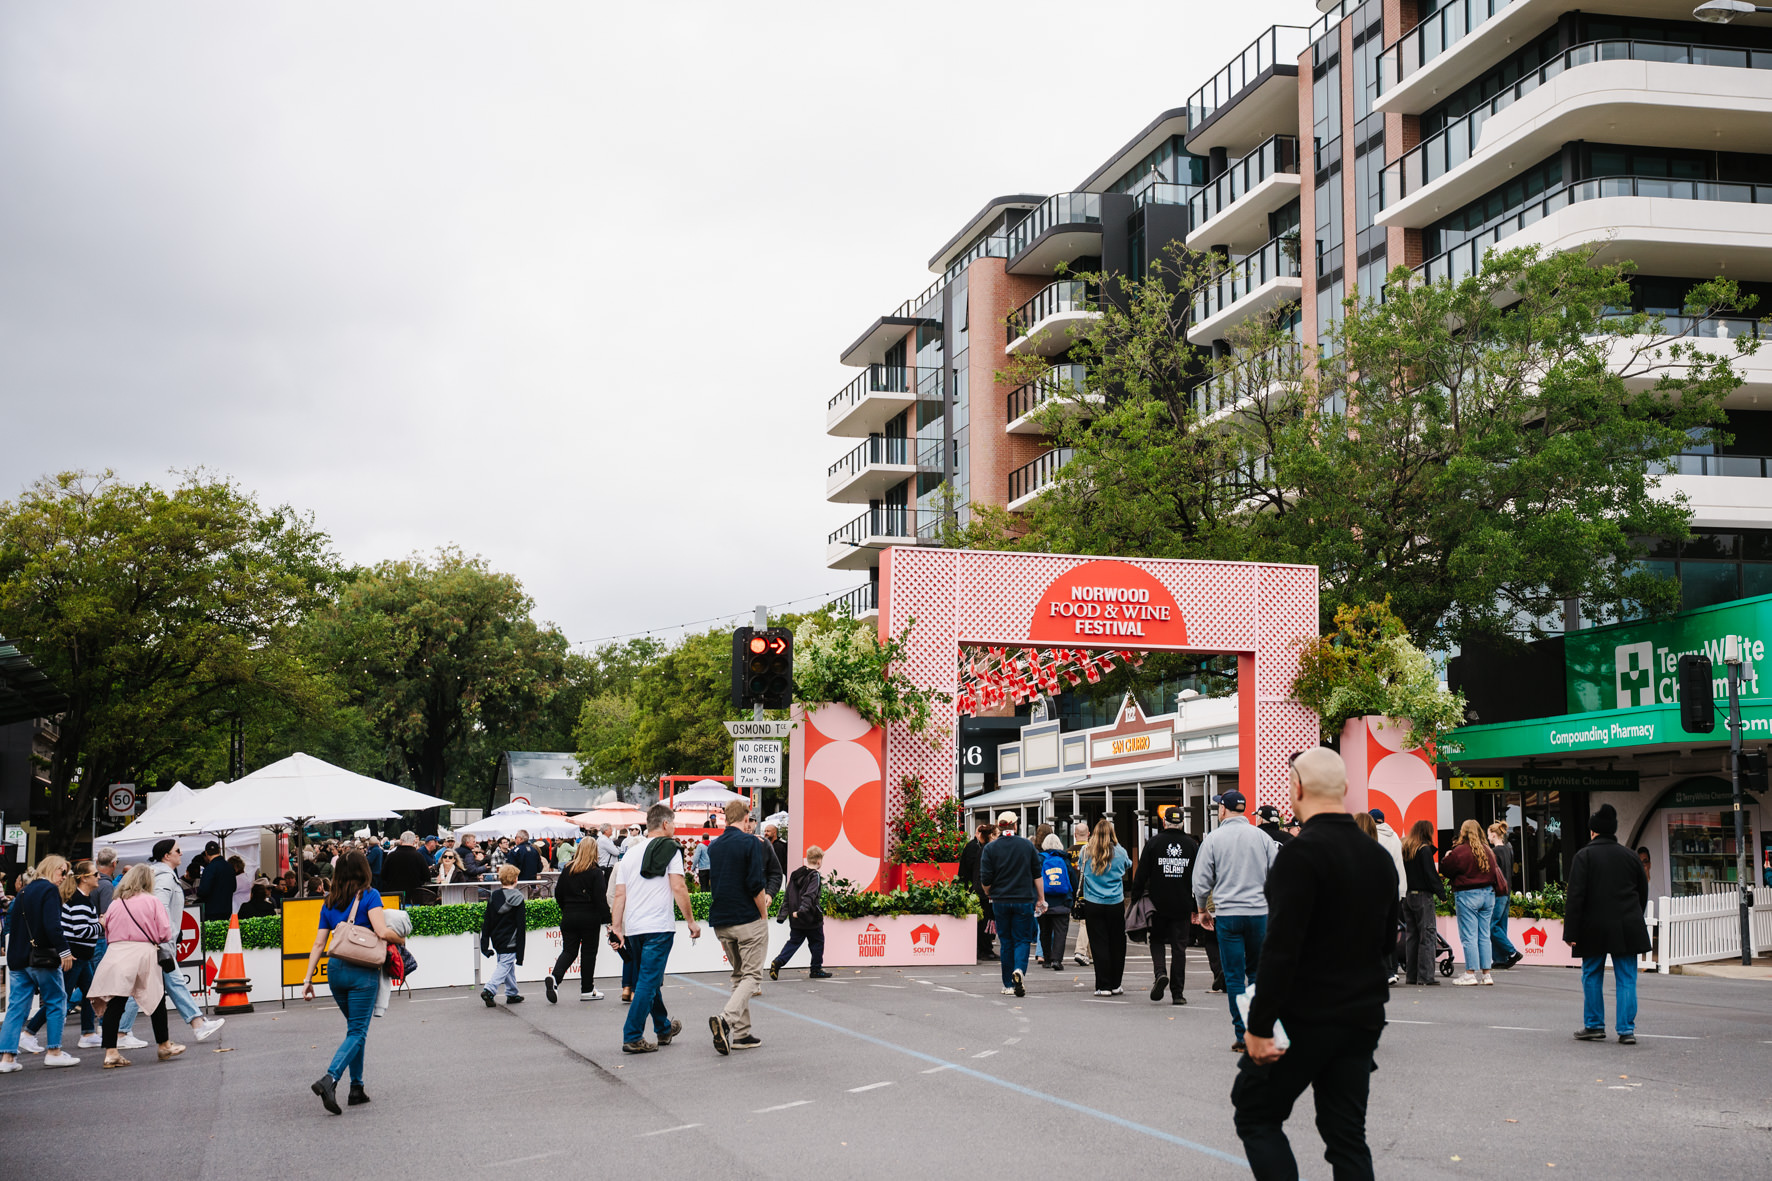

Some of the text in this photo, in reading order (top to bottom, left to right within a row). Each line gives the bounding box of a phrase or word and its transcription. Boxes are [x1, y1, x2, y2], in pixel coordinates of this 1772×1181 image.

[1071, 586, 1149, 603] NORWOOD
[1050, 602, 1171, 621] FOOD & WINE
[1075, 619, 1145, 636] FESTIVAL
[733, 724, 787, 735] OSMOND TCE
[1550, 723, 1654, 747] Compounding Pharmacy
[739, 744, 779, 752] NO GREEN
[1112, 736, 1150, 754] SAN CHURRO
[742, 755, 776, 763] ARROWS
[1529, 776, 1630, 787] TerryWhite Chemmart
[114, 794, 131, 806] 50
[9, 830, 24, 838] 2P
[1158, 858, 1189, 867] BOUNDARY
[1163, 865, 1184, 873] ISLAND
[858, 933, 886, 945] GATHER
[859, 946, 884, 957] ROUND
